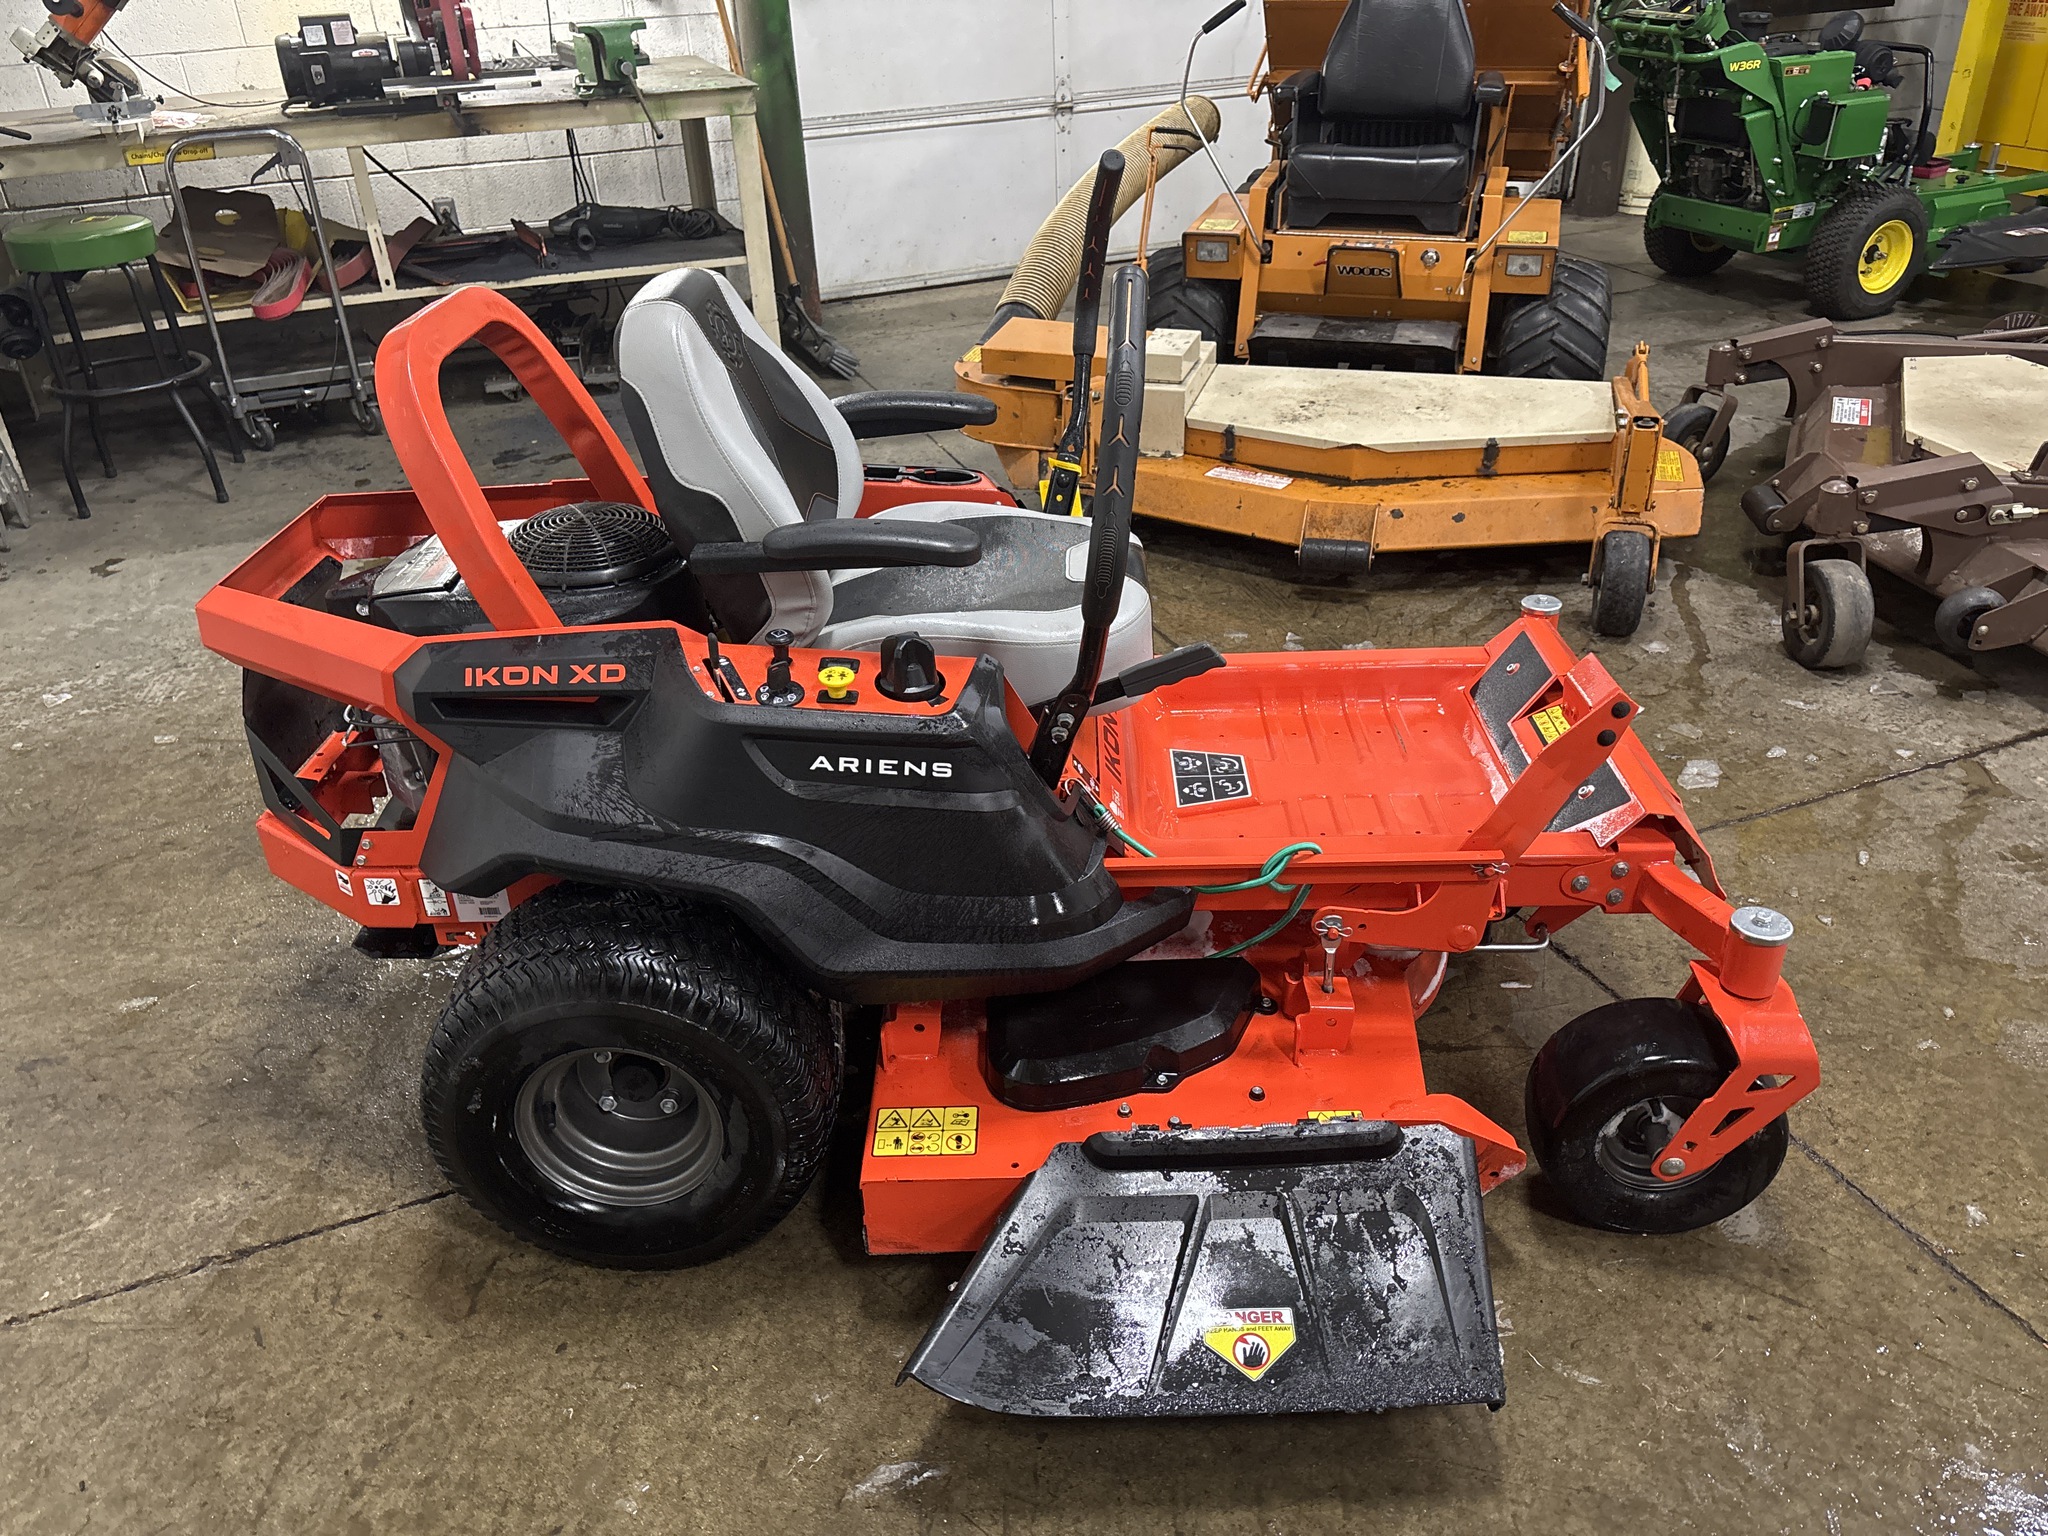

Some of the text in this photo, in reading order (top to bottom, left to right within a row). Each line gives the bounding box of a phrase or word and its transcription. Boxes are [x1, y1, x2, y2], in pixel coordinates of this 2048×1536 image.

[1729, 59, 1761, 72] W36R
[1335, 265, 1392, 278] WOODS
[464, 664, 627, 687] IKON XD
[1102, 711, 1122, 785] IKON
[809, 755, 953, 778] ARIENS
[1226, 1310, 1285, 1324] NGER
